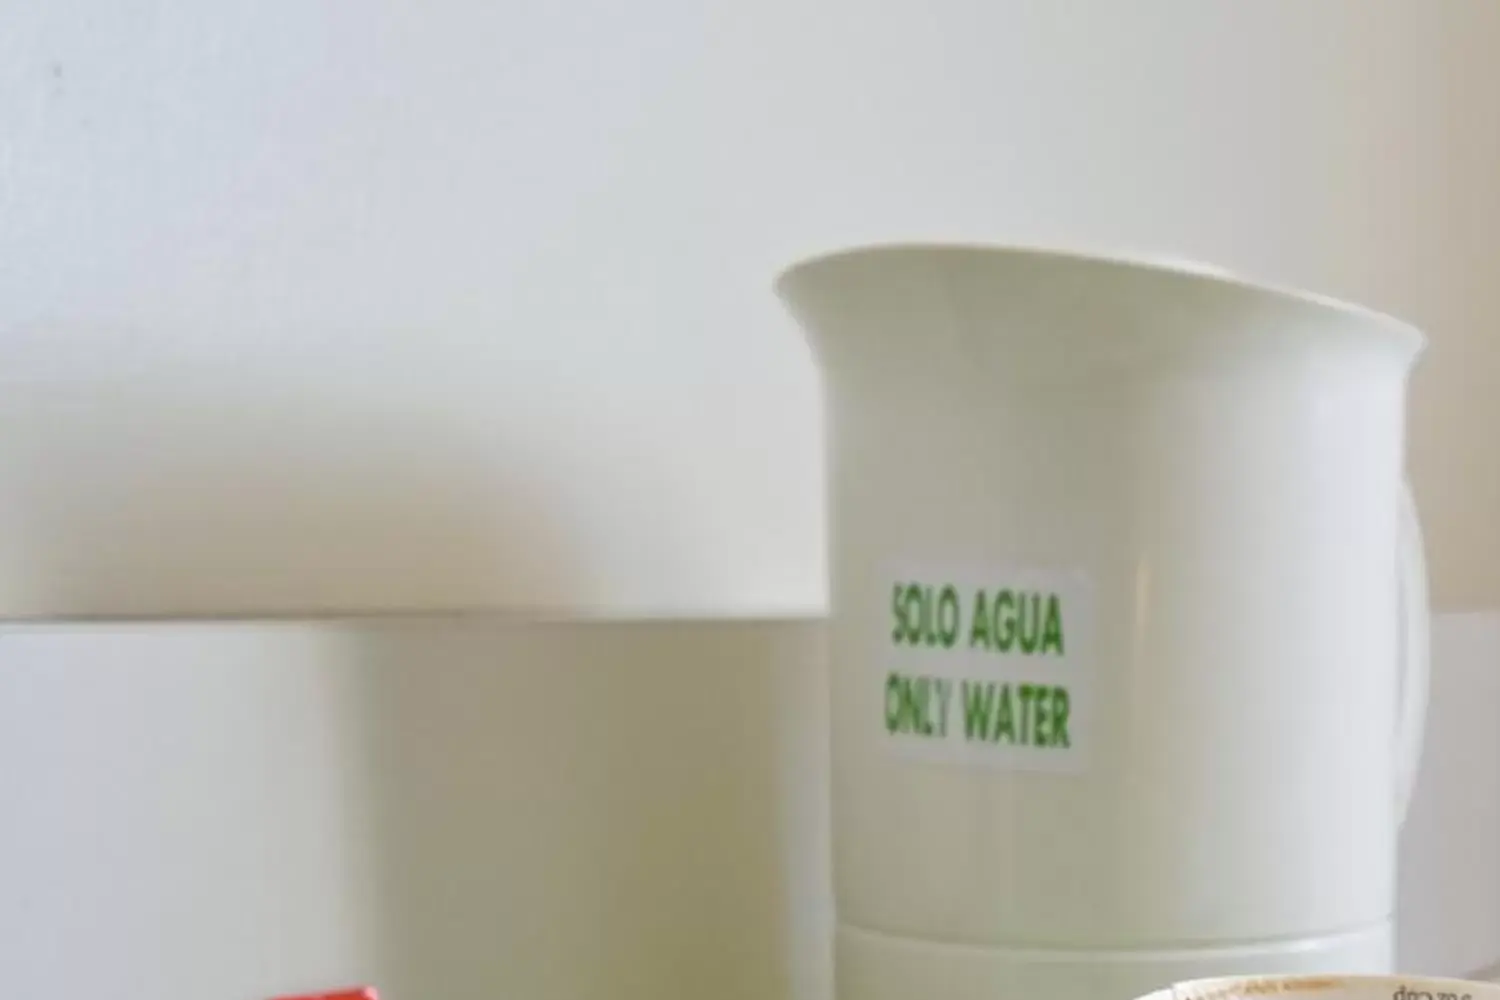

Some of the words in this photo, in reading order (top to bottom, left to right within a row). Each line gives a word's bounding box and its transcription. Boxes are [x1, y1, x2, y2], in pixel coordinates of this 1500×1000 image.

[891, 582, 959, 648] SOLO
[970, 588, 1063, 655] AGUA
[884, 673, 951, 737] ONLY
[961, 678, 1070, 748] WATER
